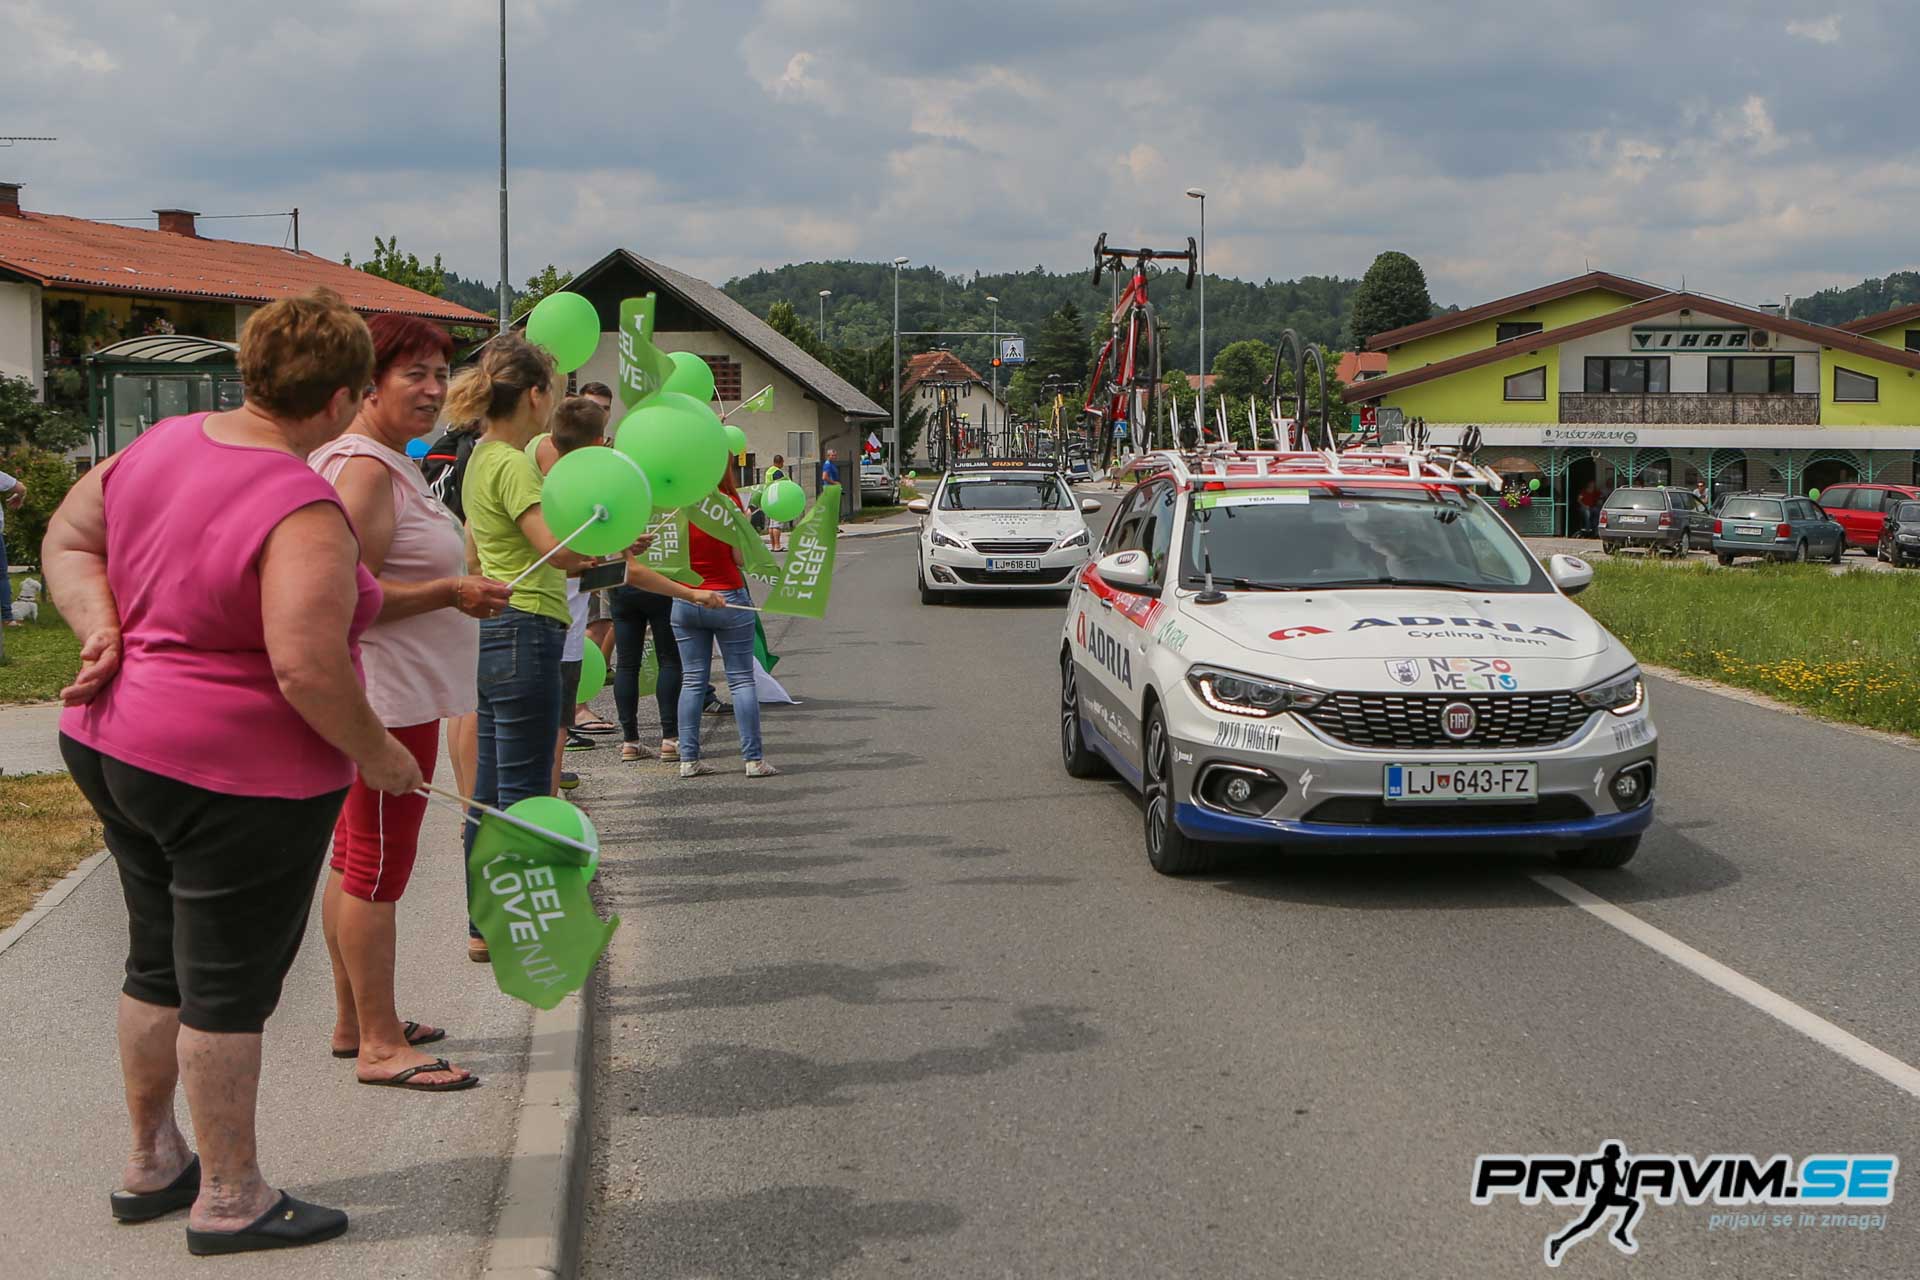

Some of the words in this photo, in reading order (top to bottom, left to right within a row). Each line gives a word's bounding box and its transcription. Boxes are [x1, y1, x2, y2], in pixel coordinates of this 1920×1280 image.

[1634, 334, 1747, 348] VIHAR
[1588, 431, 1624, 440] HRAM
[662, 523, 679, 559] FEEL
[995, 560, 1006, 568] LJ
[1347, 616, 1577, 642] ADRIA
[1408, 629, 1484, 642] Cycling
[1488, 633, 1548, 647] Team
[1088, 621, 1133, 691] ADRIA
[1435, 673, 1518, 691] MESTO
[1450, 712, 1470, 729] FIAT
[1407, 770, 1435, 794] LJ
[1453, 769, 1529, 794] 643-FZ
[523, 865, 566, 932] EEL
